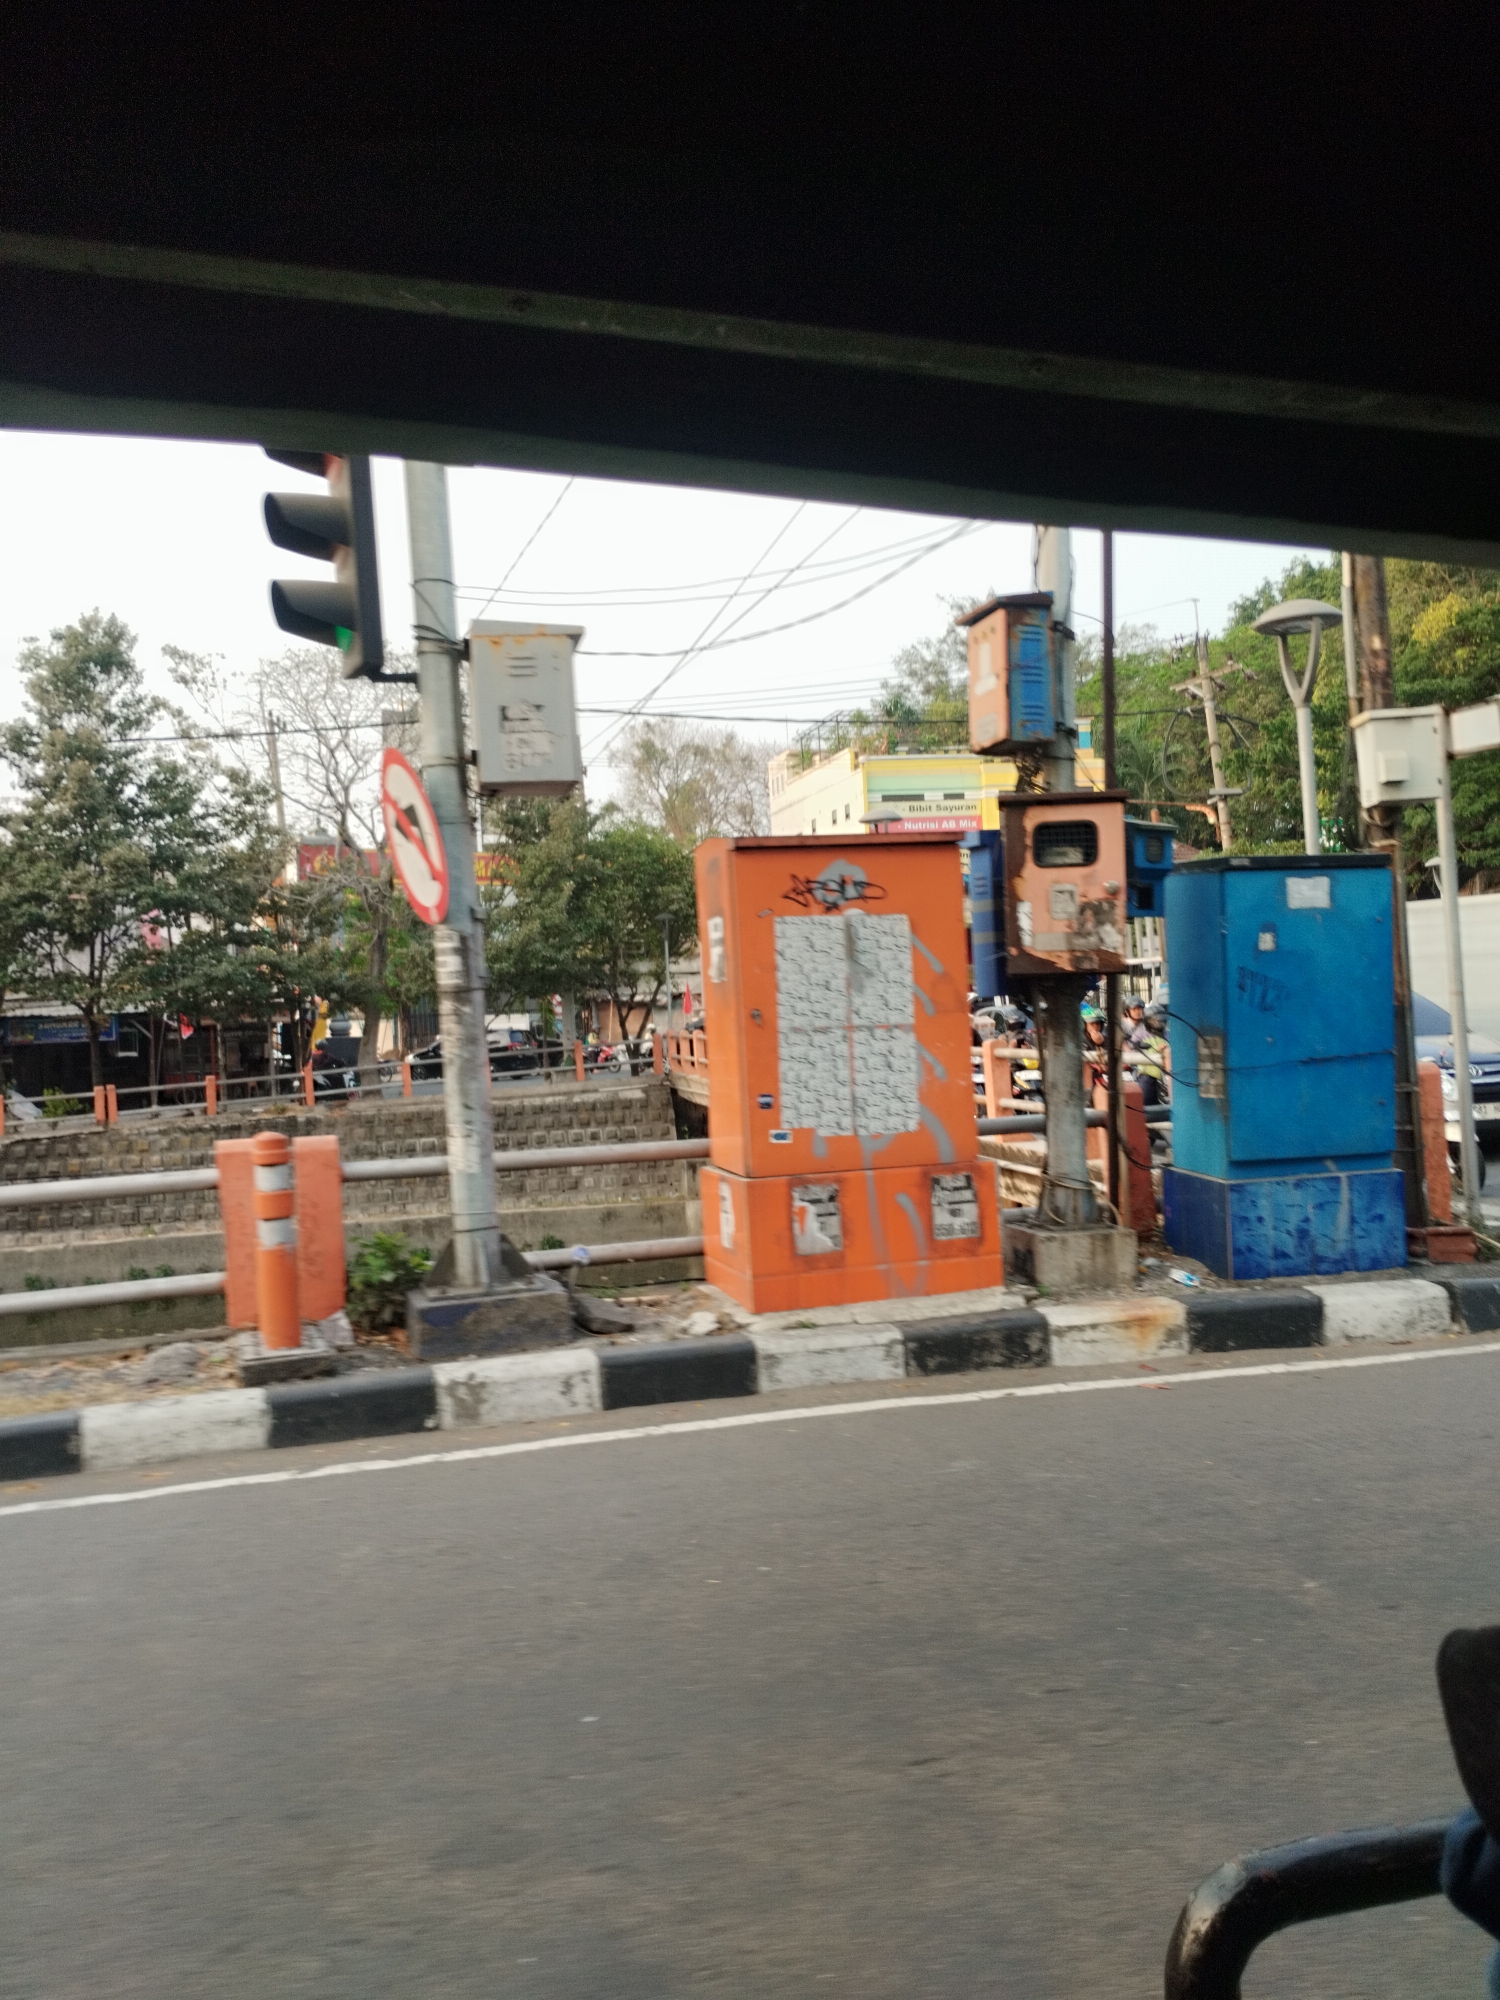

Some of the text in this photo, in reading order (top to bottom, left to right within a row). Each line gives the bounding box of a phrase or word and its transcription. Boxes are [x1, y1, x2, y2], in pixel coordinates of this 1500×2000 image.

[908, 804, 977, 813] Bibit Sayuran
[904, 818, 977, 830] Nutrisi AB Mix
